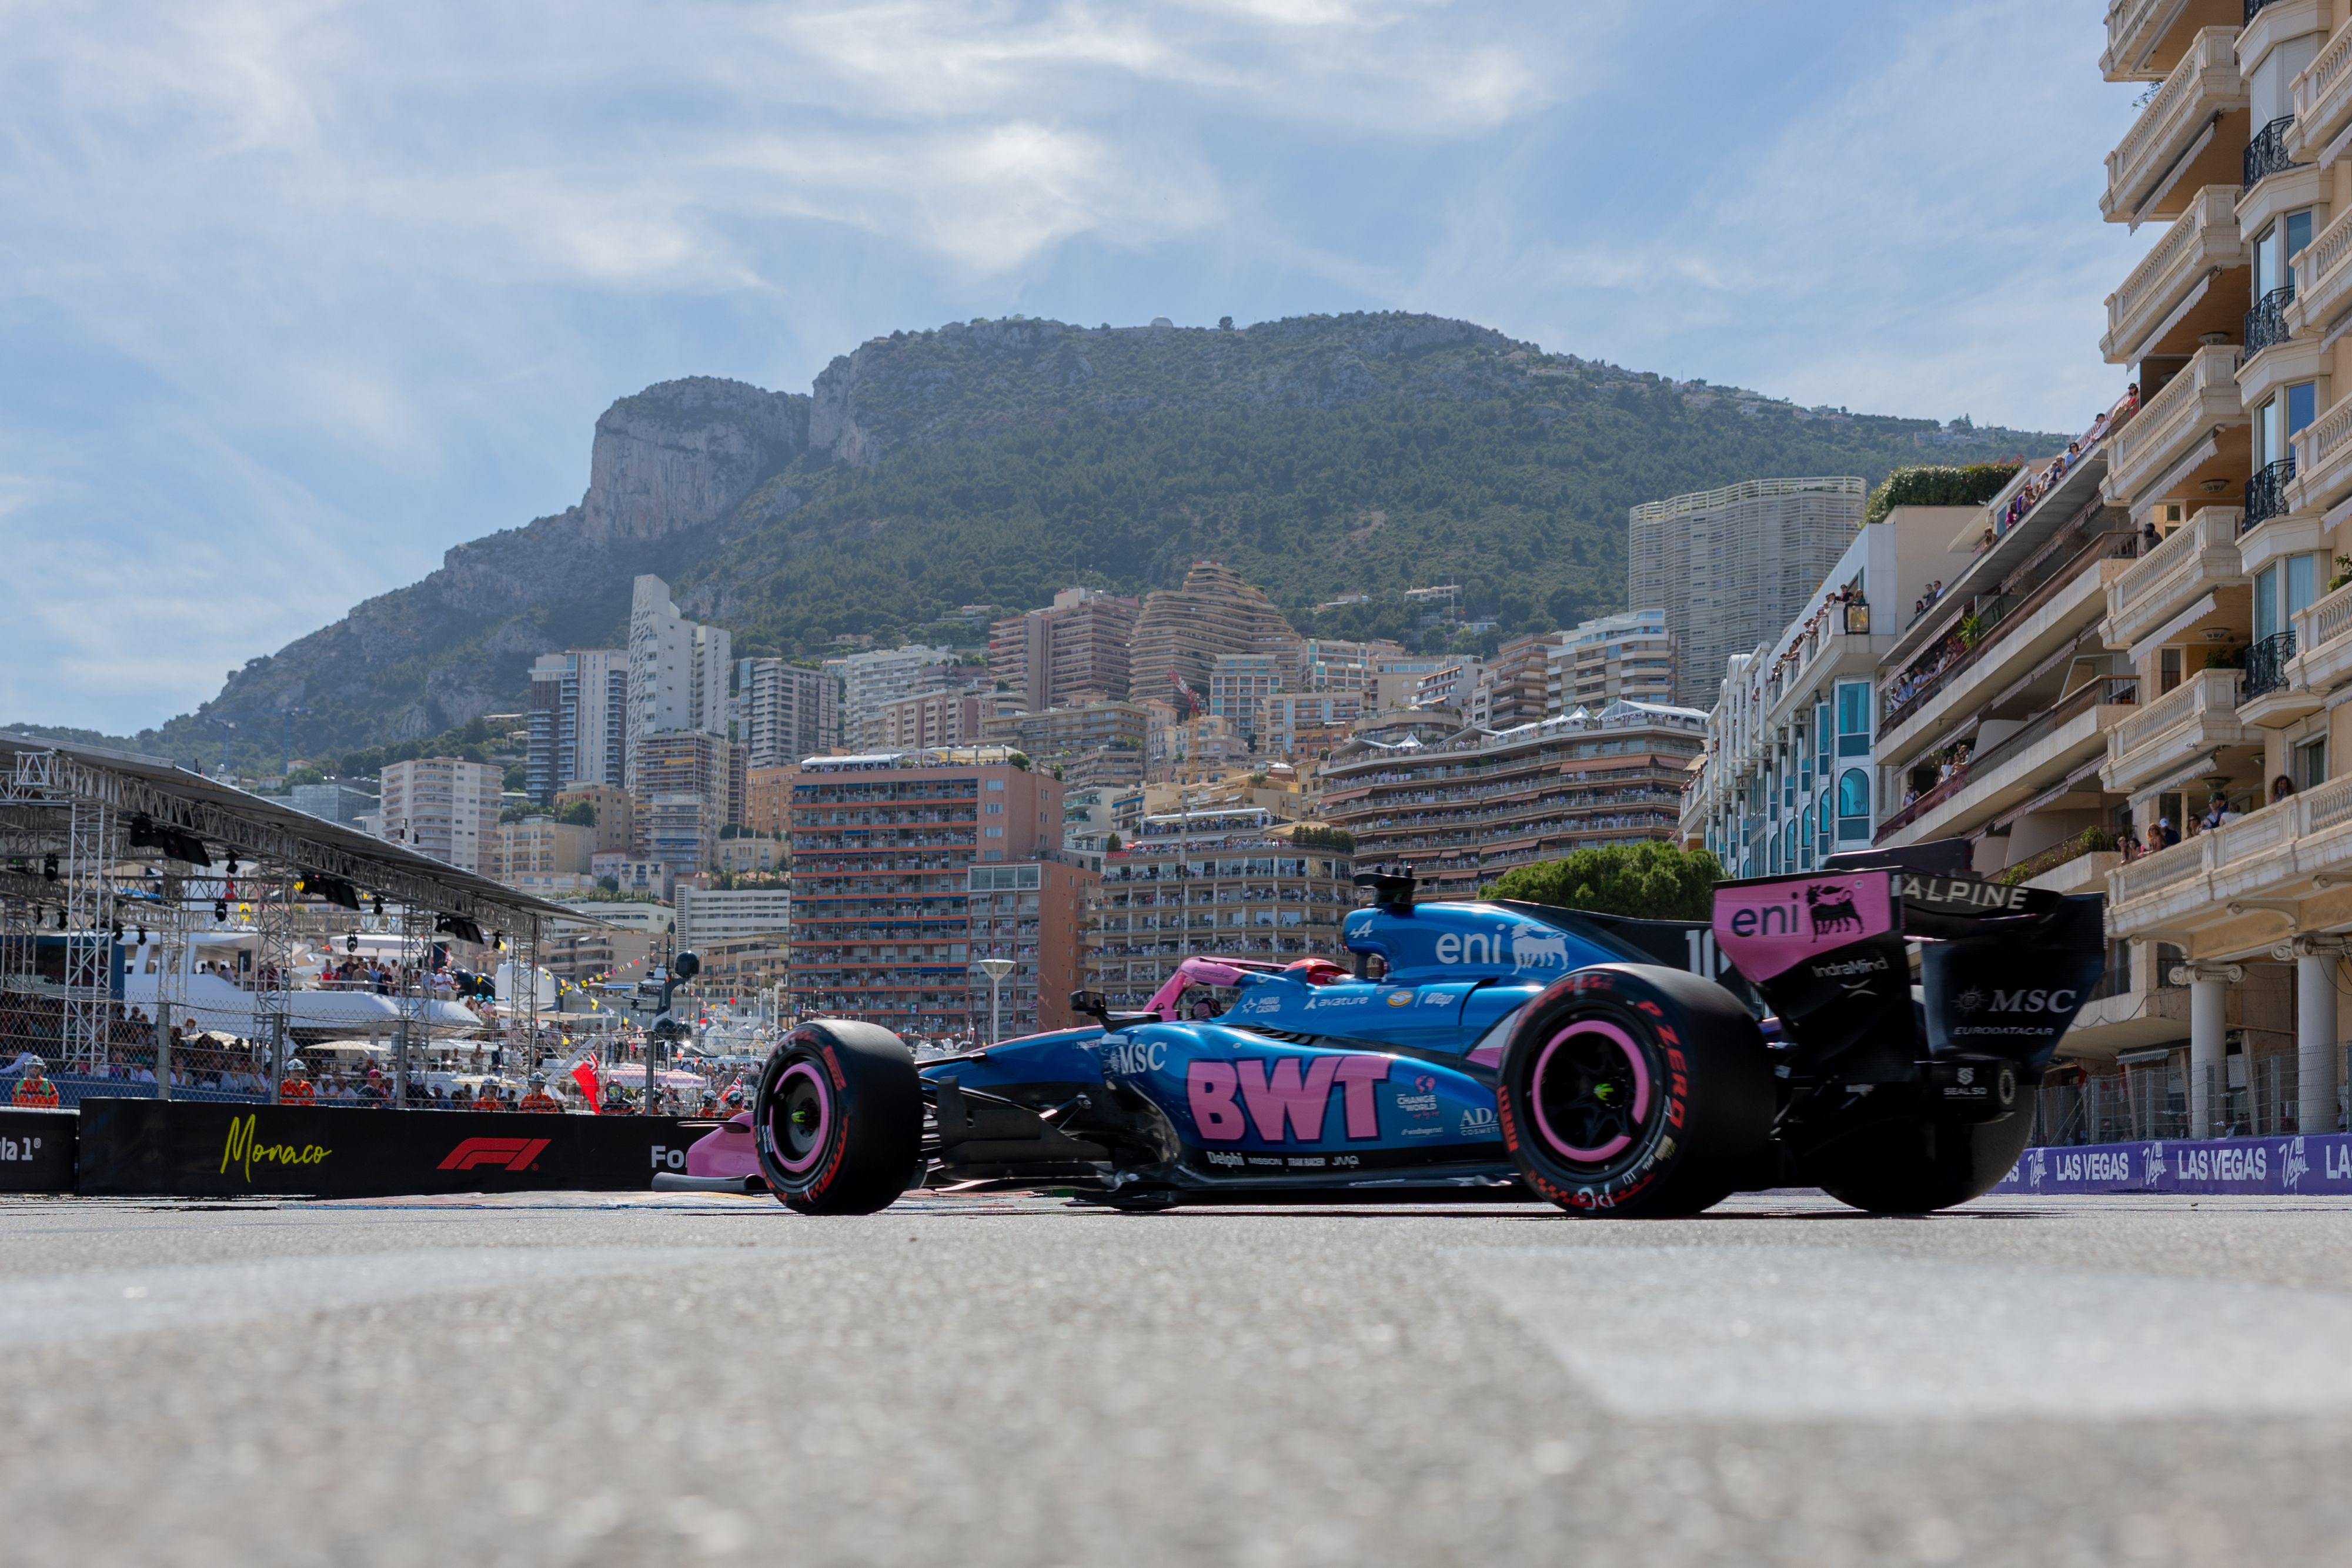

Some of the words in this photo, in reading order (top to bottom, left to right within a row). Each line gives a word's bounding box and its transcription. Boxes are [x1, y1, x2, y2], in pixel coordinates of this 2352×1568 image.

[1904, 877, 2029, 909] ALPINE
[1732, 892, 1798, 937] eni
[1436, 924, 1506, 964] eni
[1318, 997, 1369, 1007] avature
[1987, 989, 2077, 1013] MSC
[1120, 1041, 1167, 1074] MSC
[1656, 1025, 1687, 1129] ZERO
[1187, 1056, 1392, 1141] BWT
[220, 1114, 332, 1183] Monaco
[652, 1145, 687, 1168] Fo
[2056, 1154, 2081, 1181] LAS
[2083, 1152, 2129, 1181] VEGAS
[2178, 1150, 2208, 1180] LAS
[2211, 1147, 2266, 1181] VEGAS
[2326, 1144, 2352, 1179] LA
